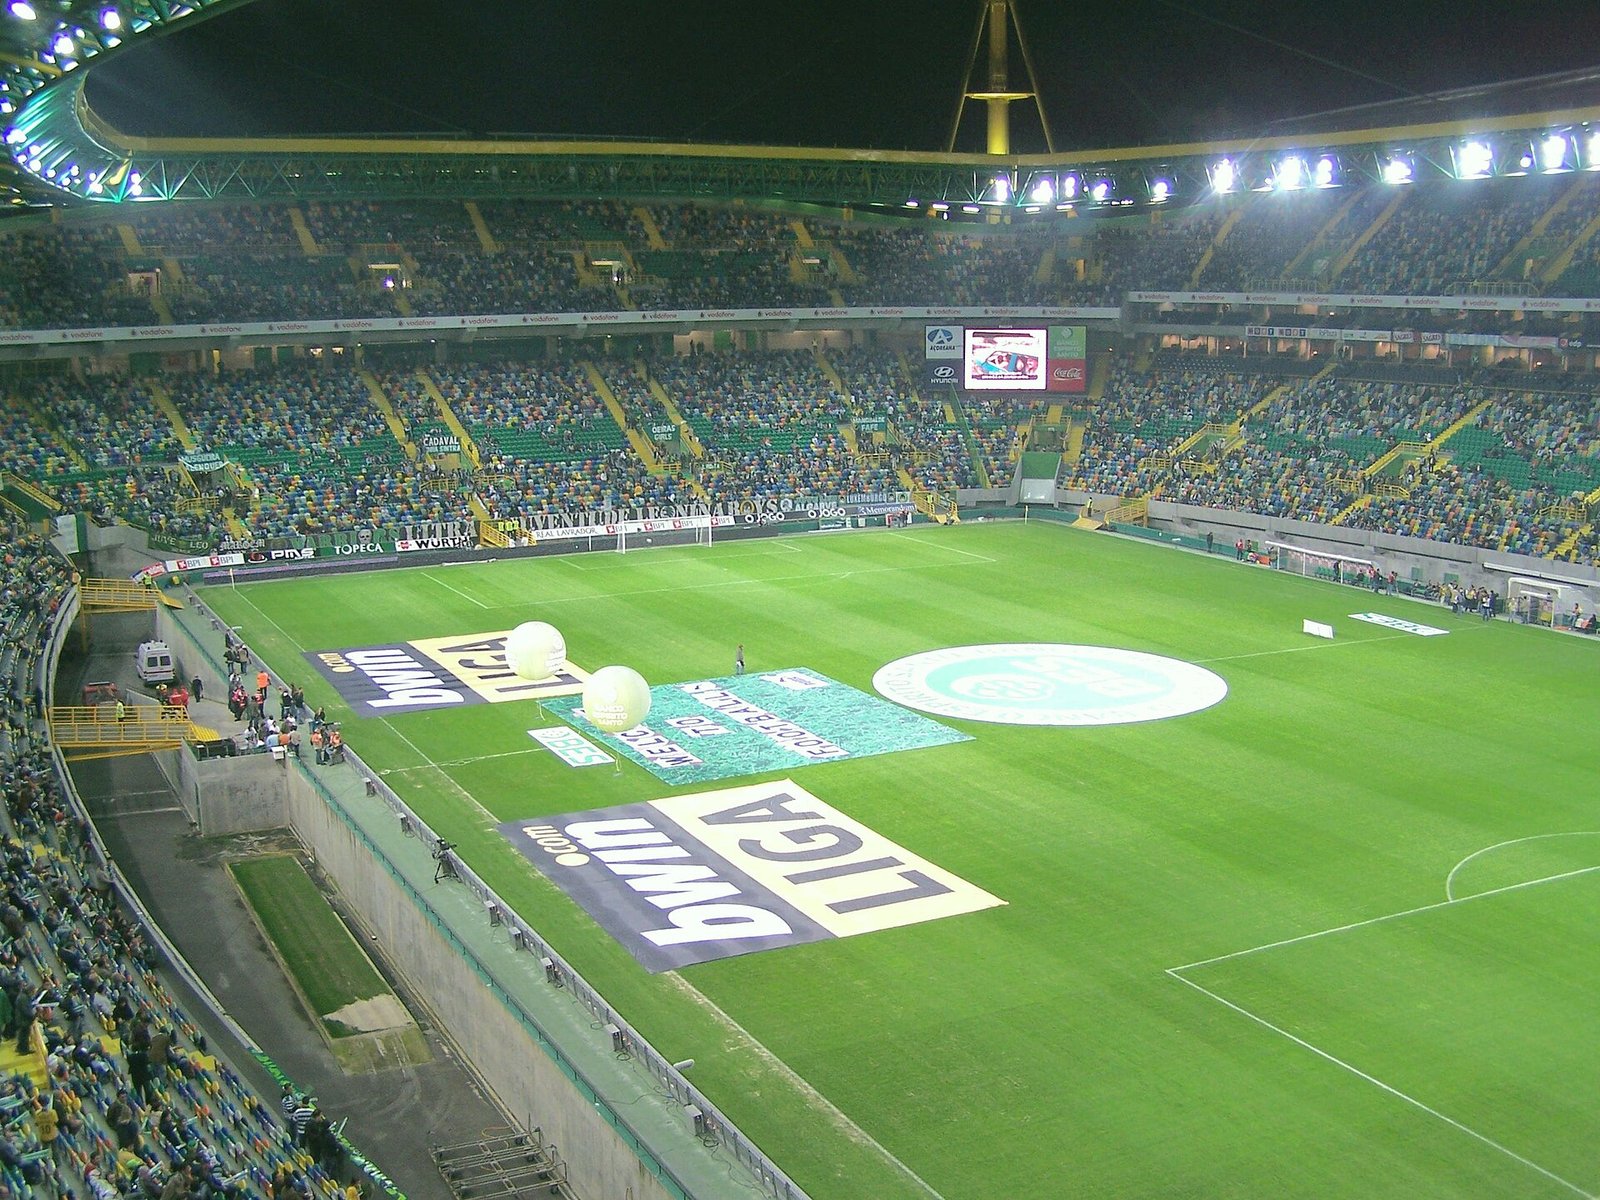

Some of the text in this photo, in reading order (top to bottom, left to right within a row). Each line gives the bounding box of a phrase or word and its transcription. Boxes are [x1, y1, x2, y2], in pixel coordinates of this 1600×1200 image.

[1469, 299, 1498, 307] vodafone
[649, 312, 678, 320] vodafone
[764, 309, 792, 317] vodafone
[468, 317, 498, 325] vodafone
[530, 315, 559, 323] vodafone
[276, 323, 308, 331] vodafone
[342, 320, 372, 328] vodafone
[140, 328, 173, 336] vodafone
[209, 325, 242, 333] vodafone
[70, 331, 104, 339] vodafone
[651, 425, 676, 433] OEIRAS
[423, 436, 459, 446] CADAVAL
[654, 433, 673, 441] GIRLS
[846, 492, 887, 504] LUXEMBURGO
[795, 501, 838, 512] ALGARVE
[818, 507, 846, 518] JOGO
[718, 517, 731, 525] BPI
[757, 512, 785, 523] JOGO
[681, 520, 694, 528] BPI
[536, 526, 599, 539] REAL LAVRADOR
[189, 541, 209, 550] LEO
[334, 542, 384, 555] TOPECA
[271, 547, 315, 560] PMS
[187, 559, 201, 568] BPI
[219, 556, 234, 564] BPI
[344, 648, 464, 708] bwin
[676, 718, 720, 737] TO
[705, 692, 839, 757] FOOTBALL
[548, 738, 611, 765] BES
[699, 792, 956, 914] LIGA
[564, 817, 793, 947] bwin
